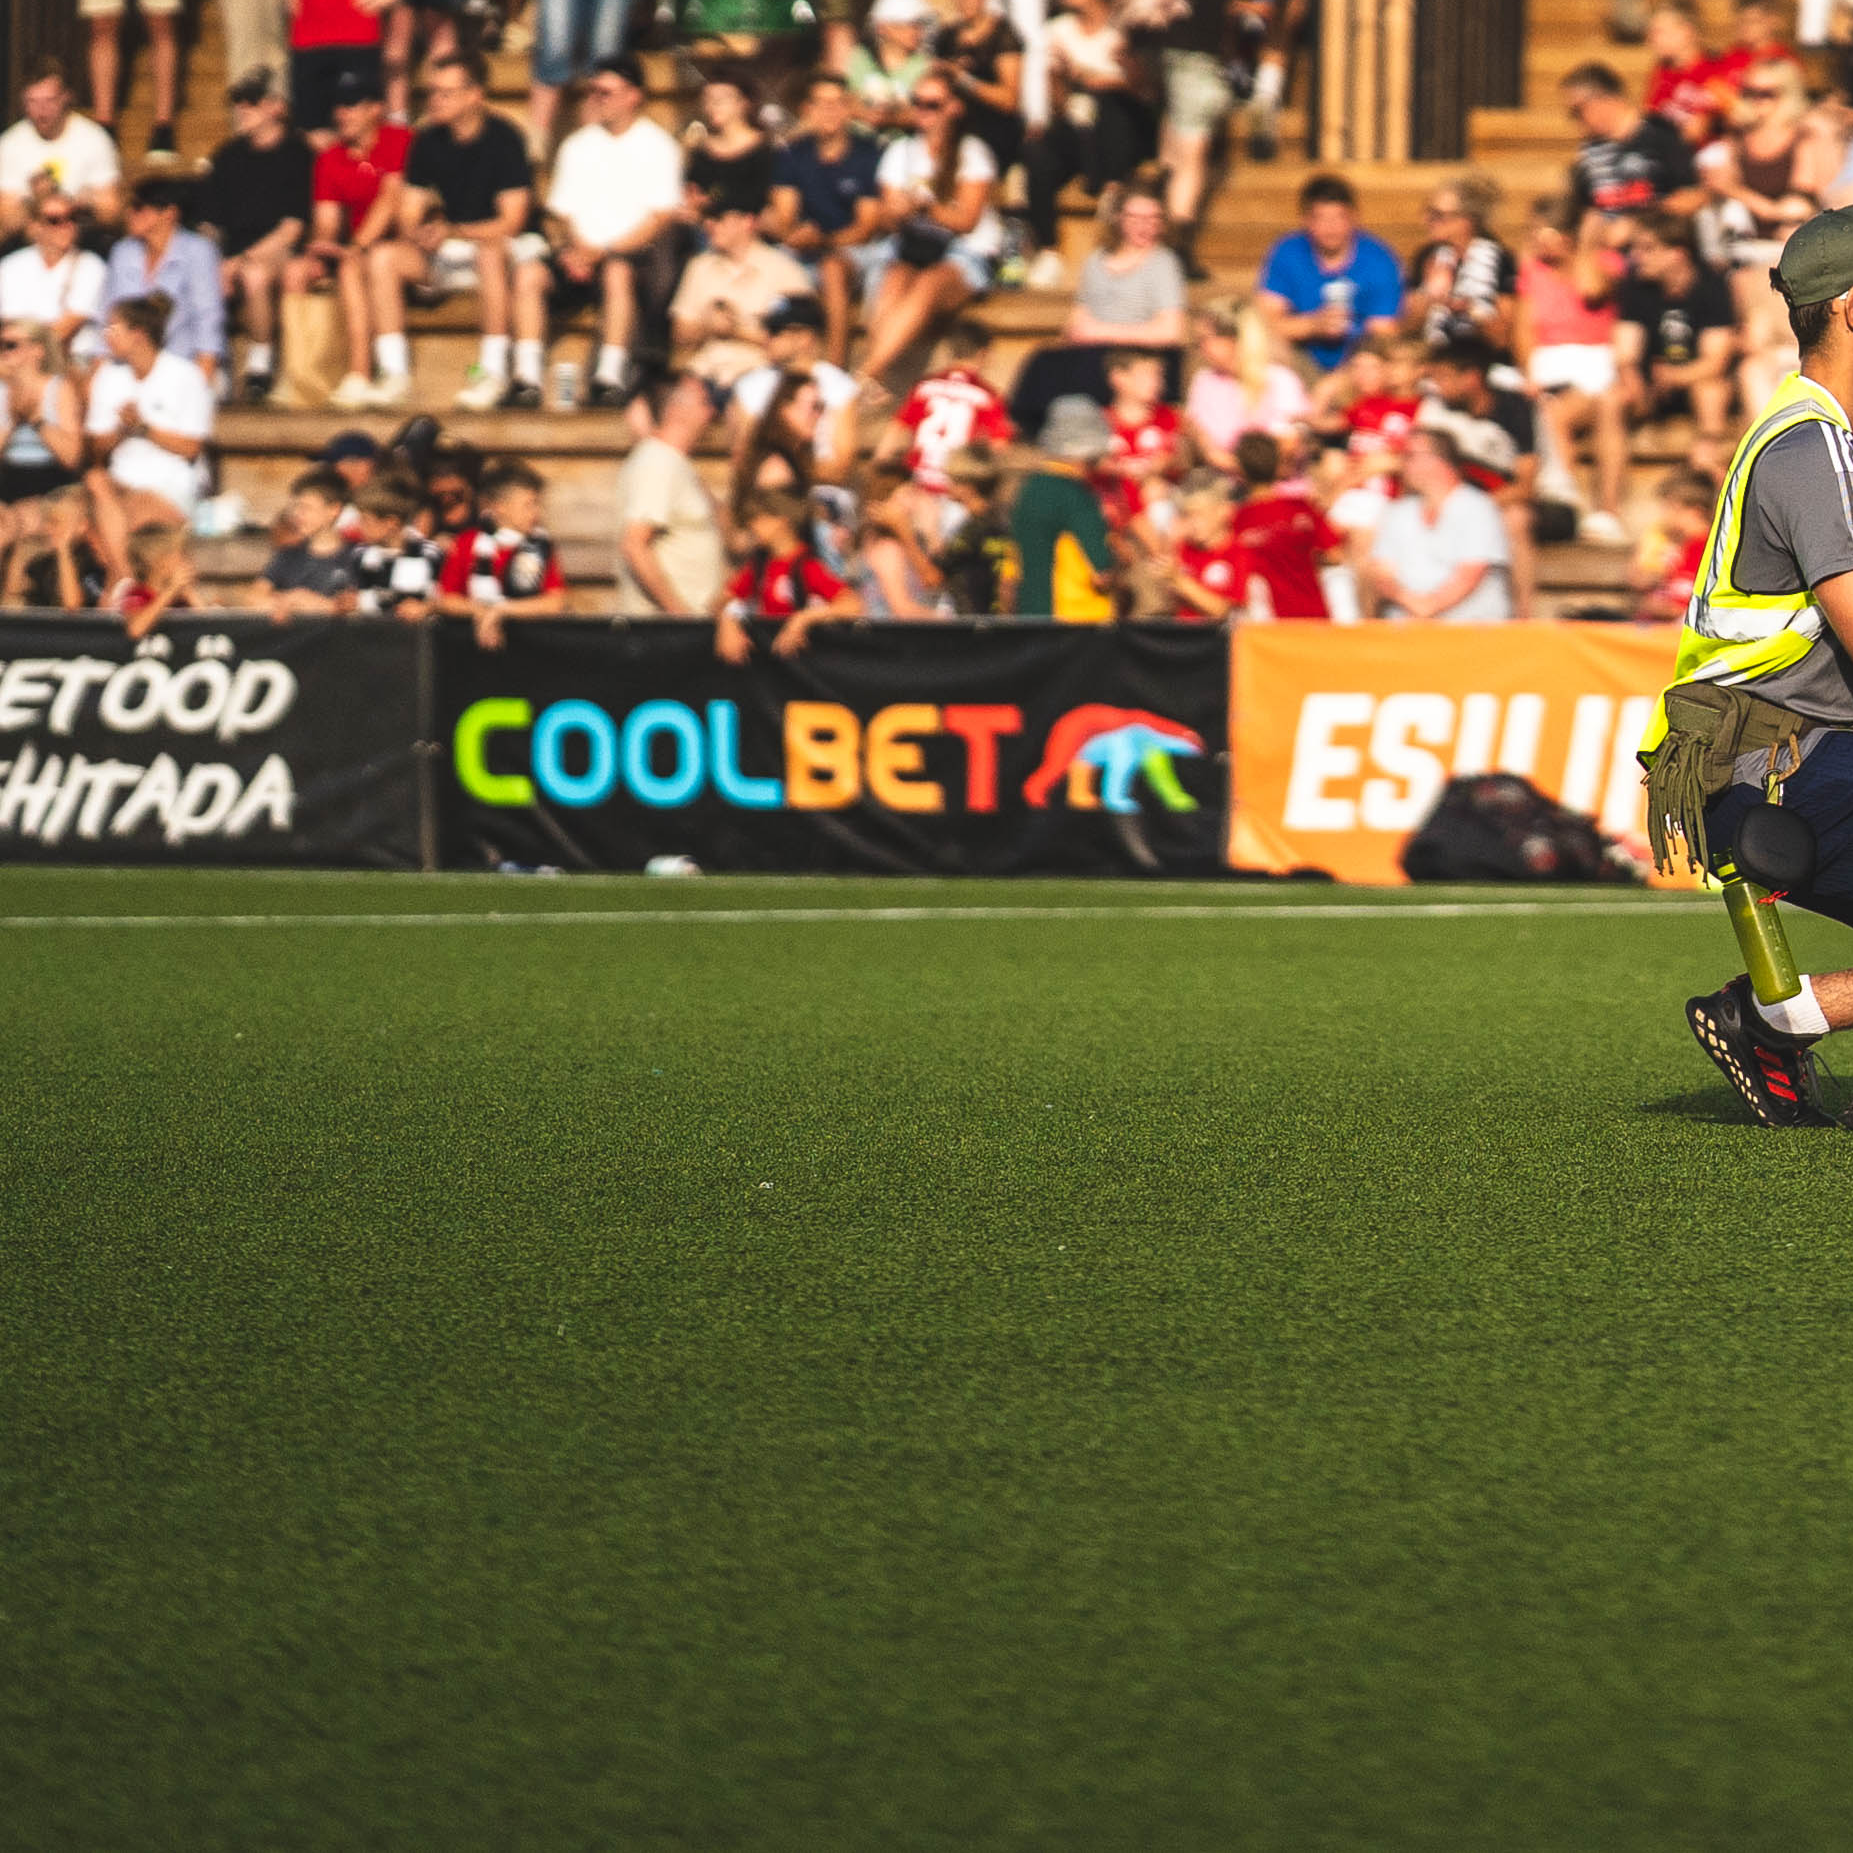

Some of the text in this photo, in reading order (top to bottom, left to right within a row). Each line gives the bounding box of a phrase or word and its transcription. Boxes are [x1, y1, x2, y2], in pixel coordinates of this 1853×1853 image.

[0, 633, 299, 744] ETÖÖD
[0, 742, 298, 846] HITADA
[453, 698, 1021, 814] COOLBET
